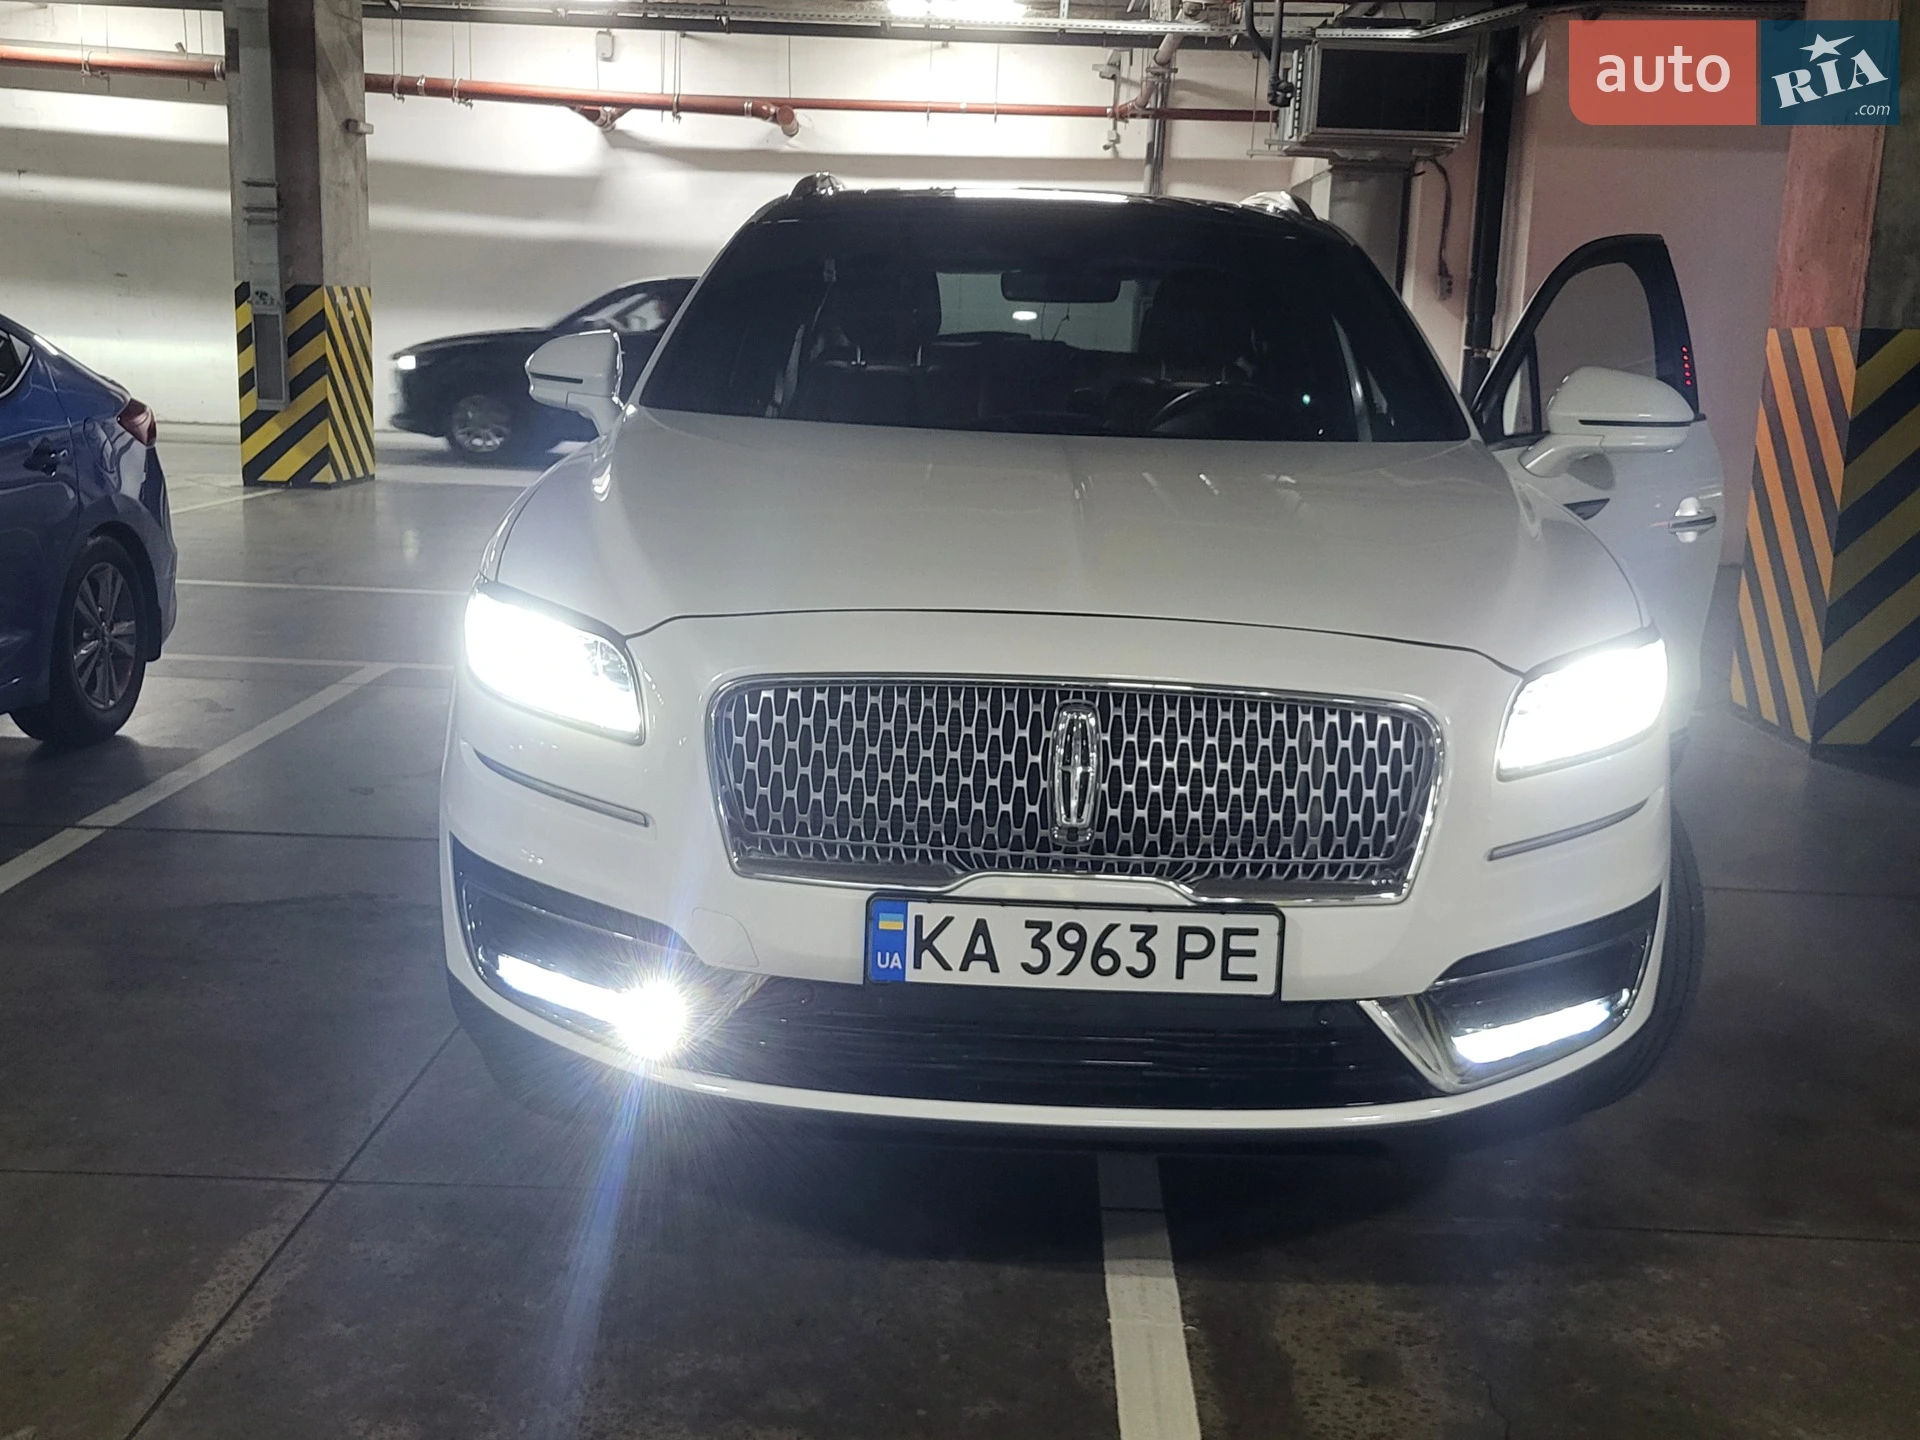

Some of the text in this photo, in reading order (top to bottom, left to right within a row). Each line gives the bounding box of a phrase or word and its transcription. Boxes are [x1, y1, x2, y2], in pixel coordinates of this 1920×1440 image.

[877, 951, 902, 969] UA
[913, 914, 1260, 982] KA 3963 PE
